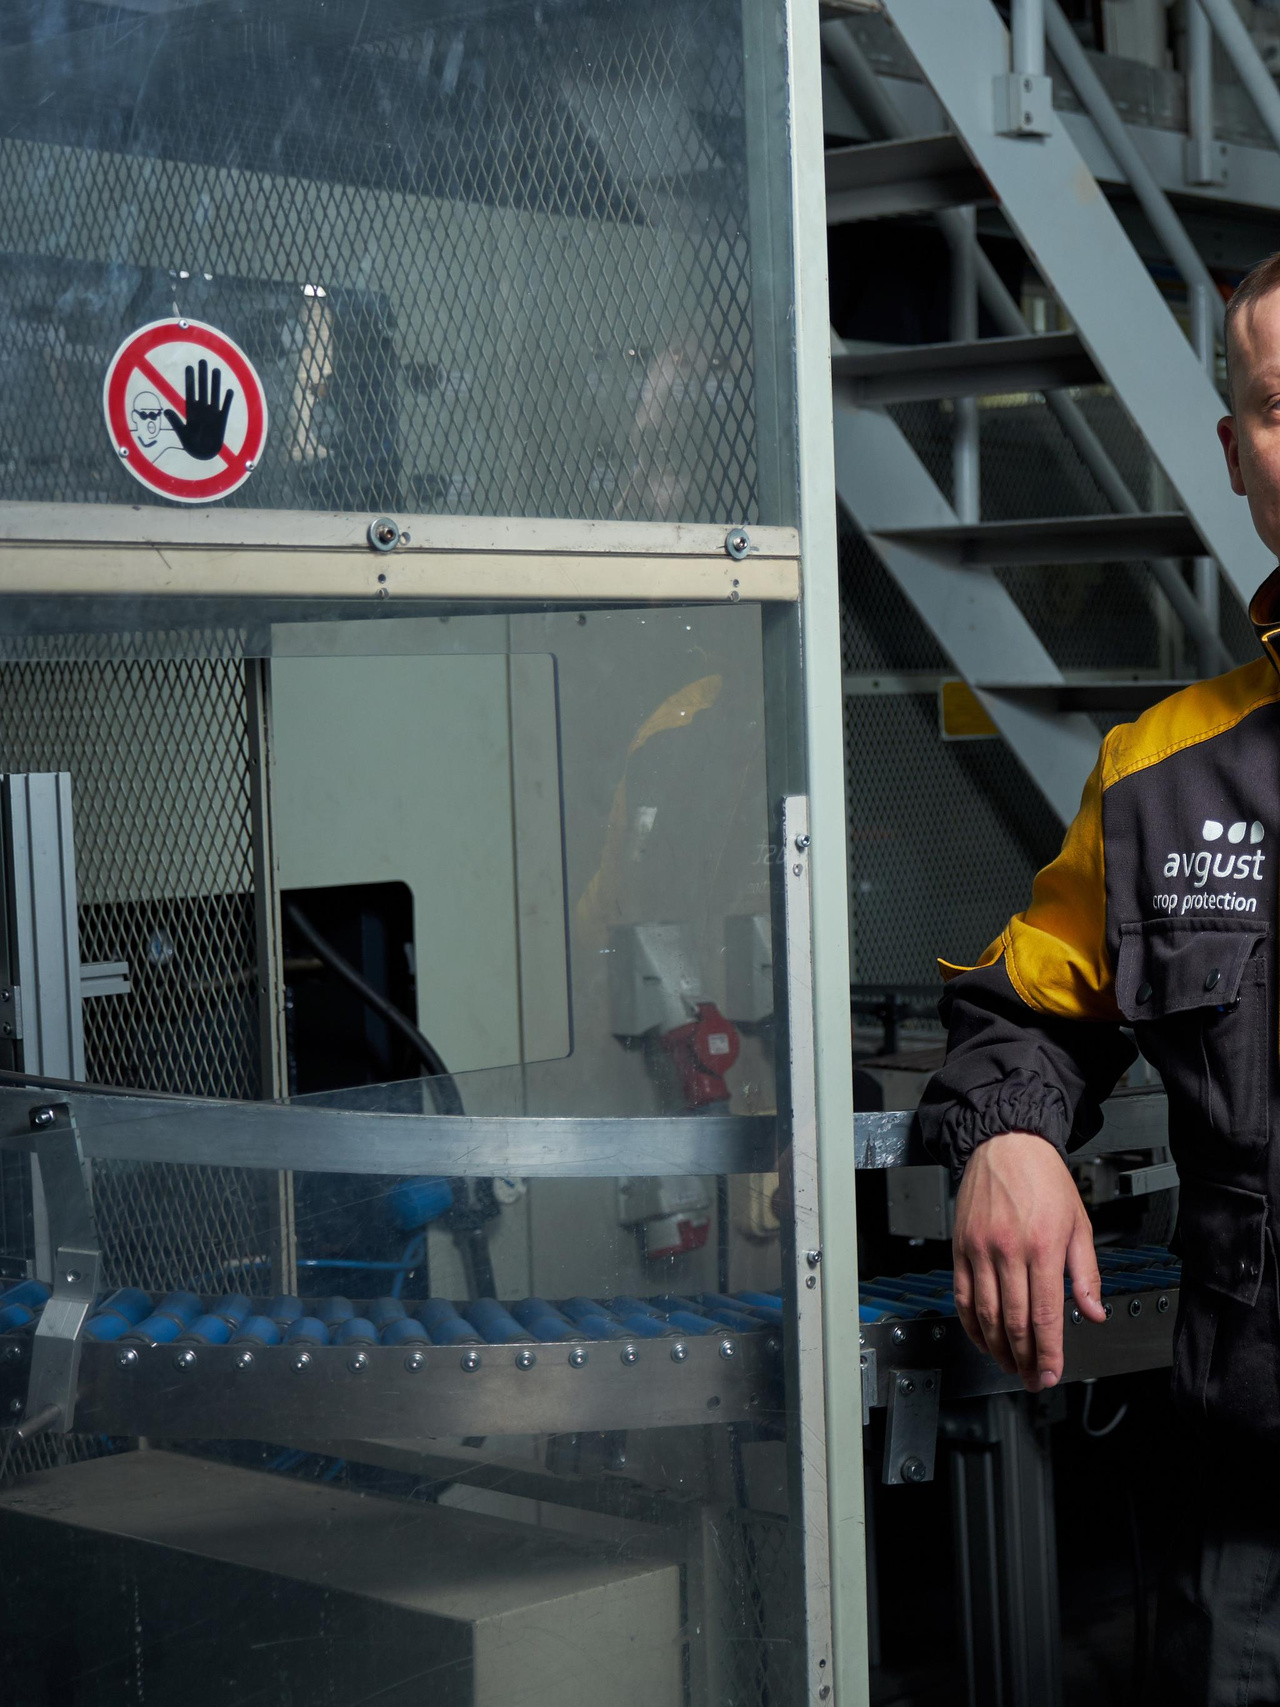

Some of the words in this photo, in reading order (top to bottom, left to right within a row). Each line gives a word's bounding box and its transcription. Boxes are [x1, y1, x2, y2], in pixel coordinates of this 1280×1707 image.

[1163, 849, 1266, 888] avgust
[1152, 893, 1179, 914] crop
[1181, 891, 1257, 915] protection
